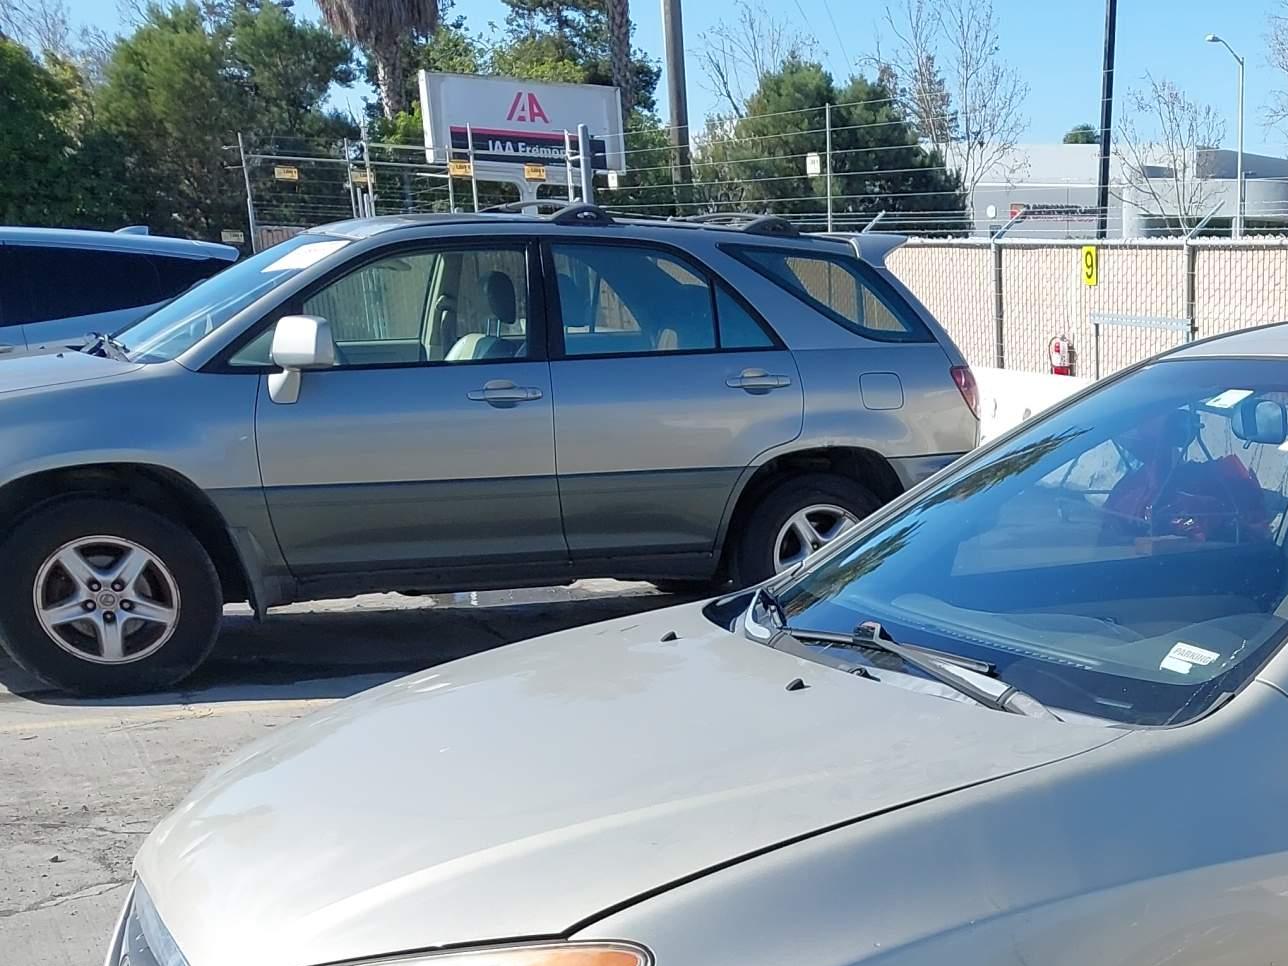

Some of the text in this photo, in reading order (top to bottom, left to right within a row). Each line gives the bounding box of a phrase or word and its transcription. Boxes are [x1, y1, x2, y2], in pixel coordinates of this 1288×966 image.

[488, 140, 515, 153] IAA
[1085, 251, 1094, 279] 9
[1172, 647, 1212, 664] PARKING
